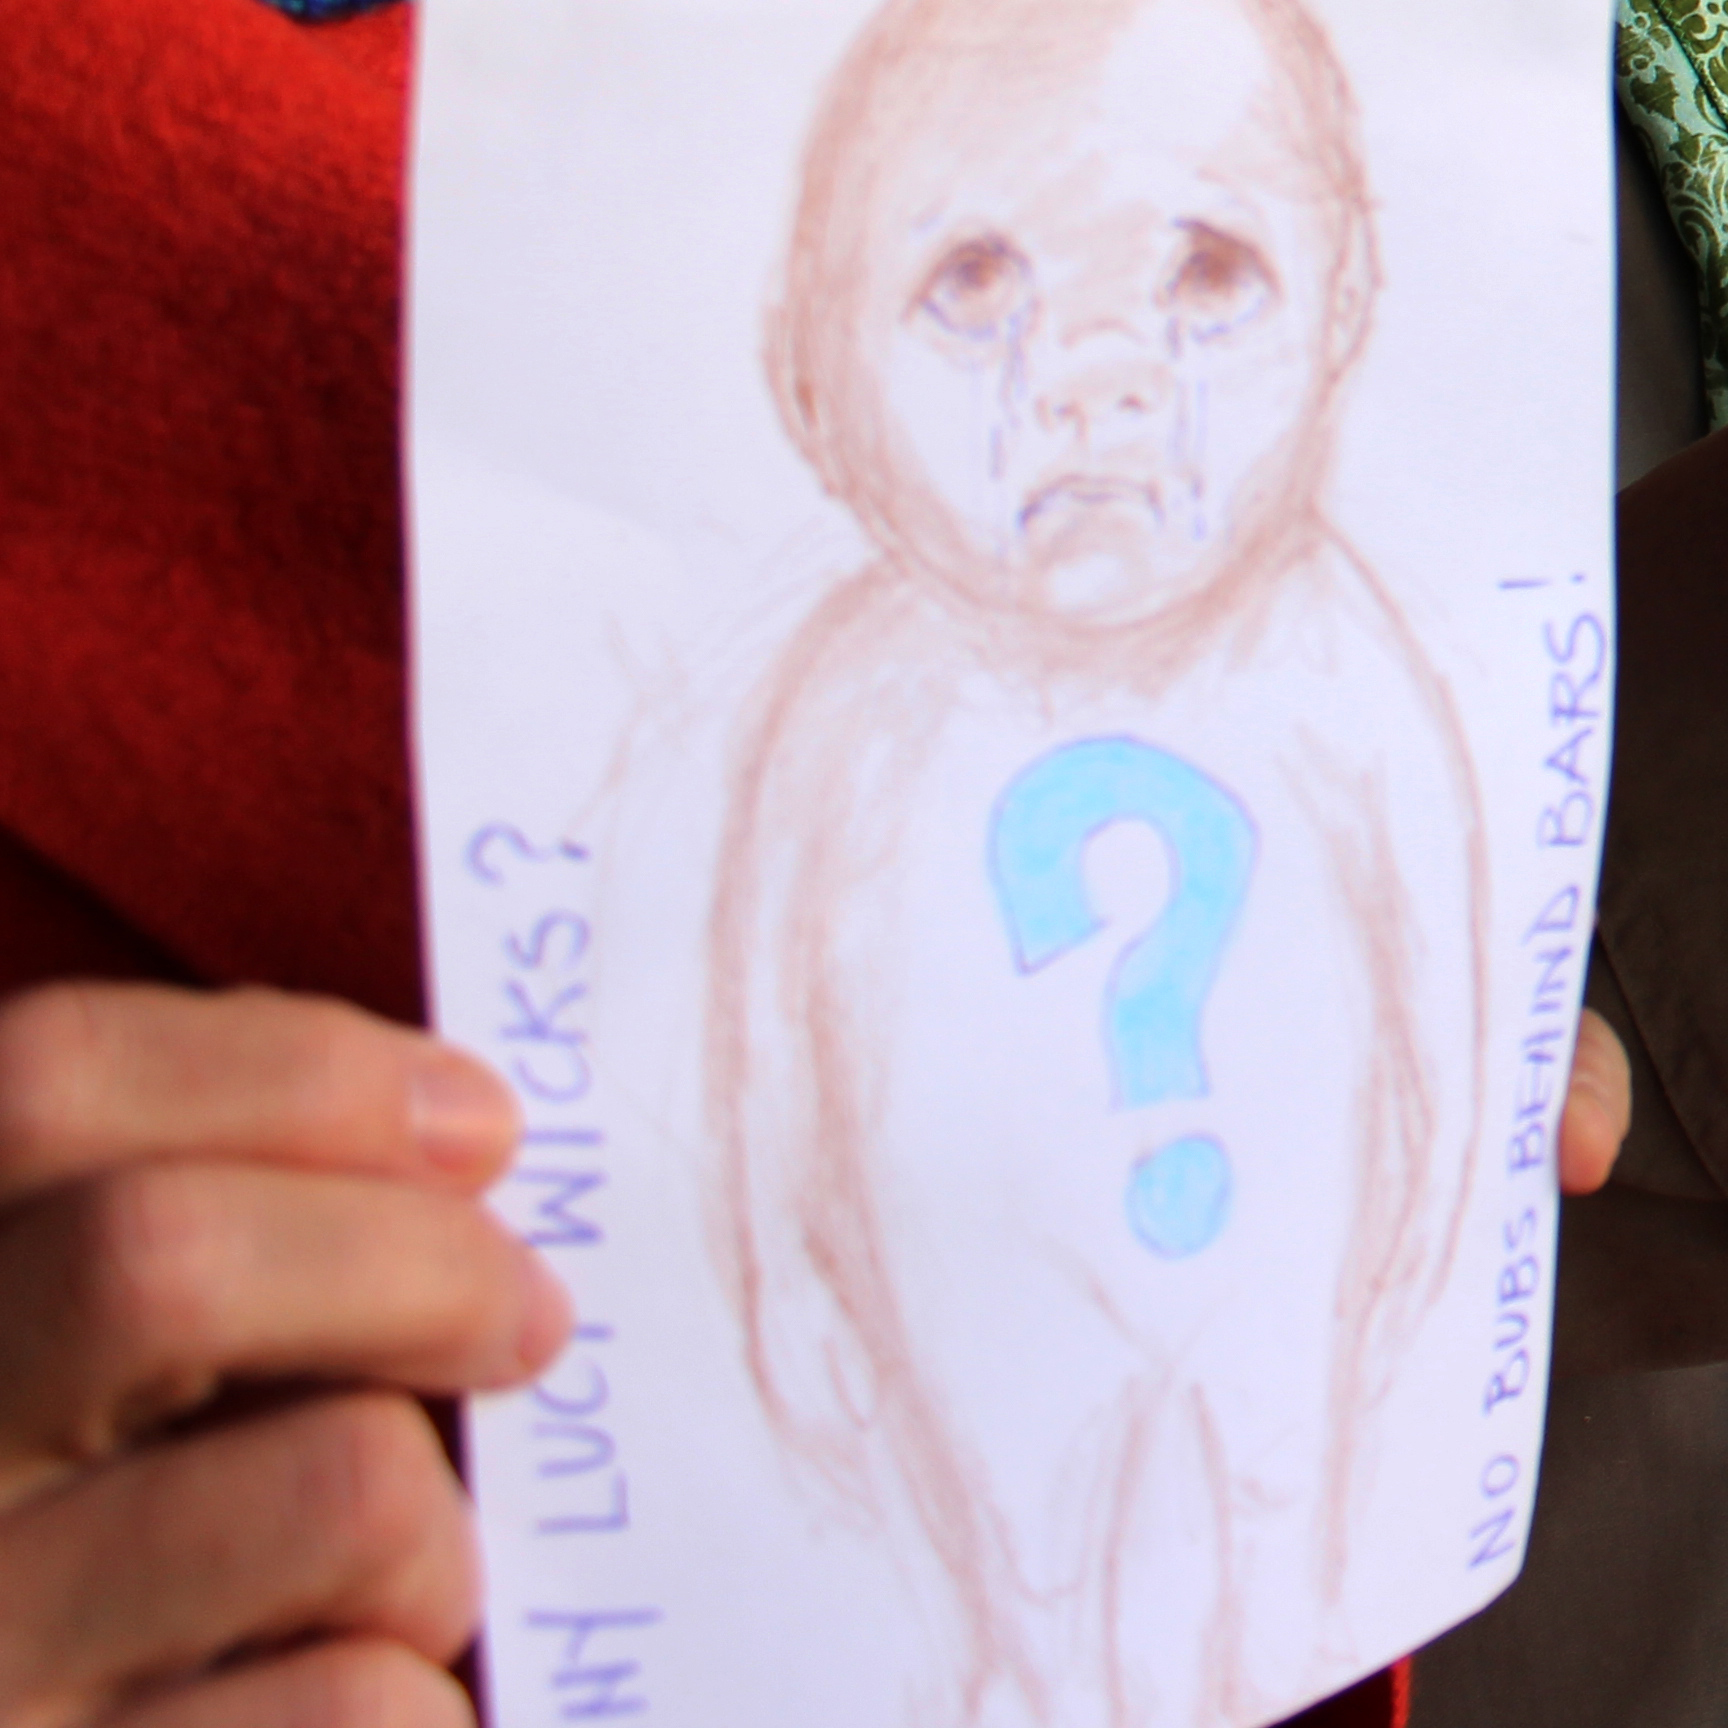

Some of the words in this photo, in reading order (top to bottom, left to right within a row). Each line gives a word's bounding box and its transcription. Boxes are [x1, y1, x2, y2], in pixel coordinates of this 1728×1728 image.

[1495, 571, 1607, 850] BARS!
[464, 821, 608, 1250] WICKS?
[1506, 882, 1580, 1174] BEHIND
[1484, 1206, 1540, 1416] BUBS
[1468, 1452, 1521, 1570] NO
[524, 1608, 664, 1722] HY
